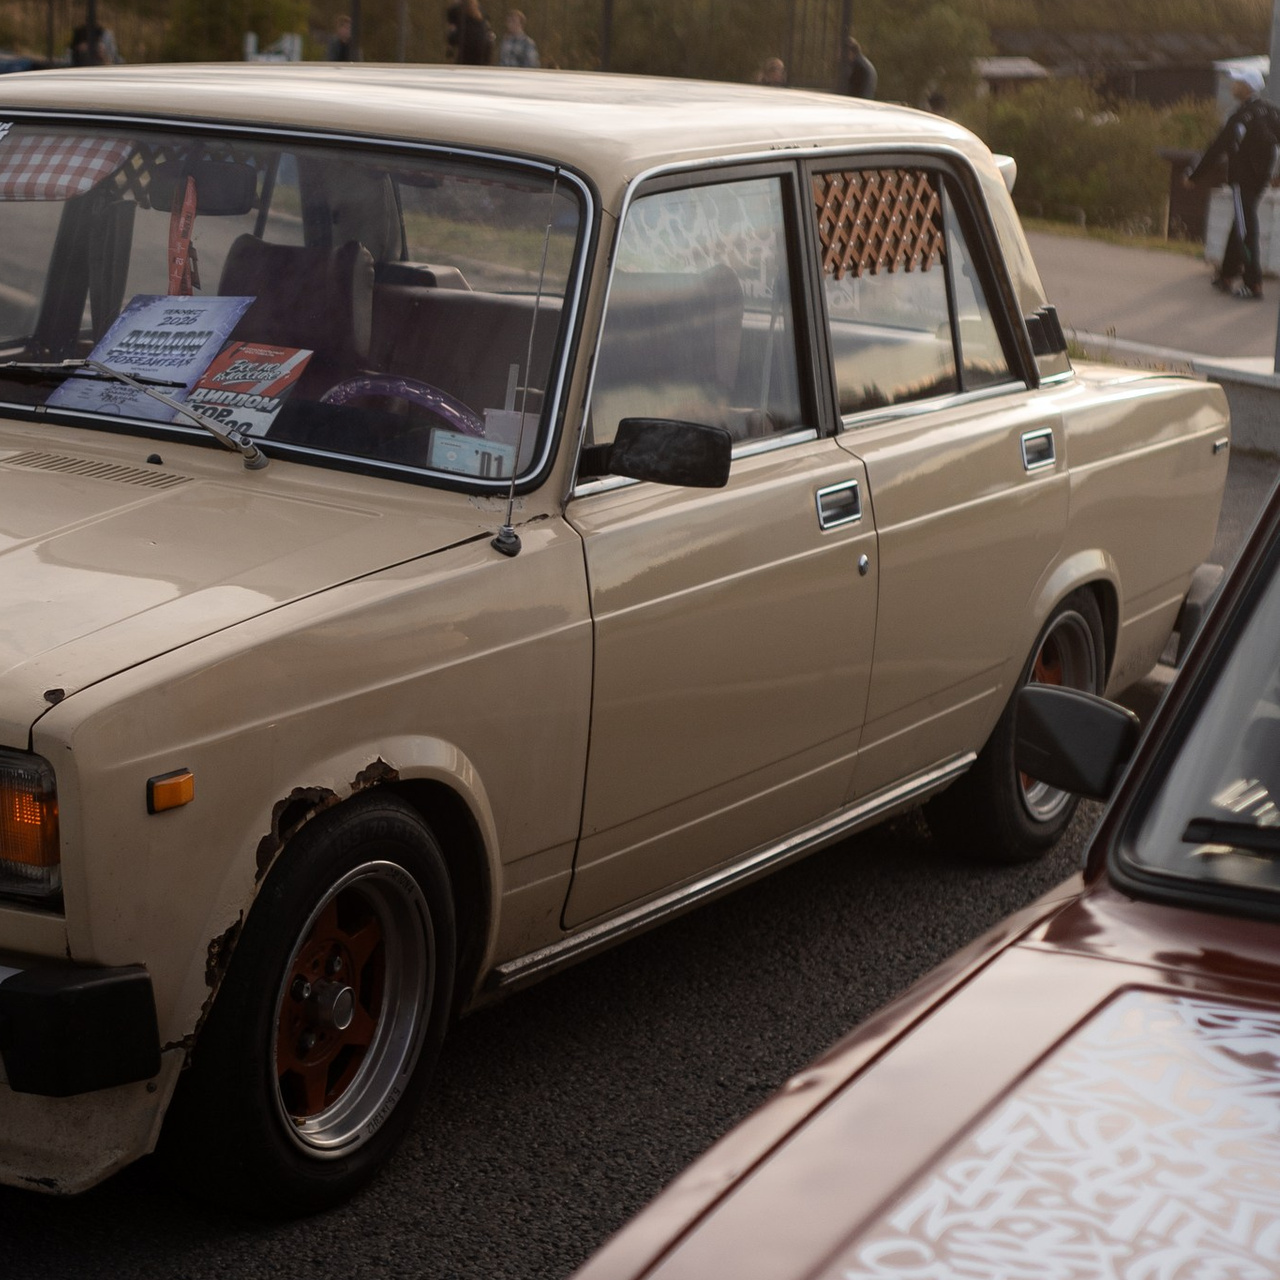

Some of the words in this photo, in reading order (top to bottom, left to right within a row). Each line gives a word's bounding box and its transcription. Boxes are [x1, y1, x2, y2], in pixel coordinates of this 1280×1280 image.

[107, 330, 214, 357] ДИПЛОМ
[103, 355, 197, 368] ПОБЕДИТЕЛЯ
[186, 388, 281, 413] ДИПЛОМ
